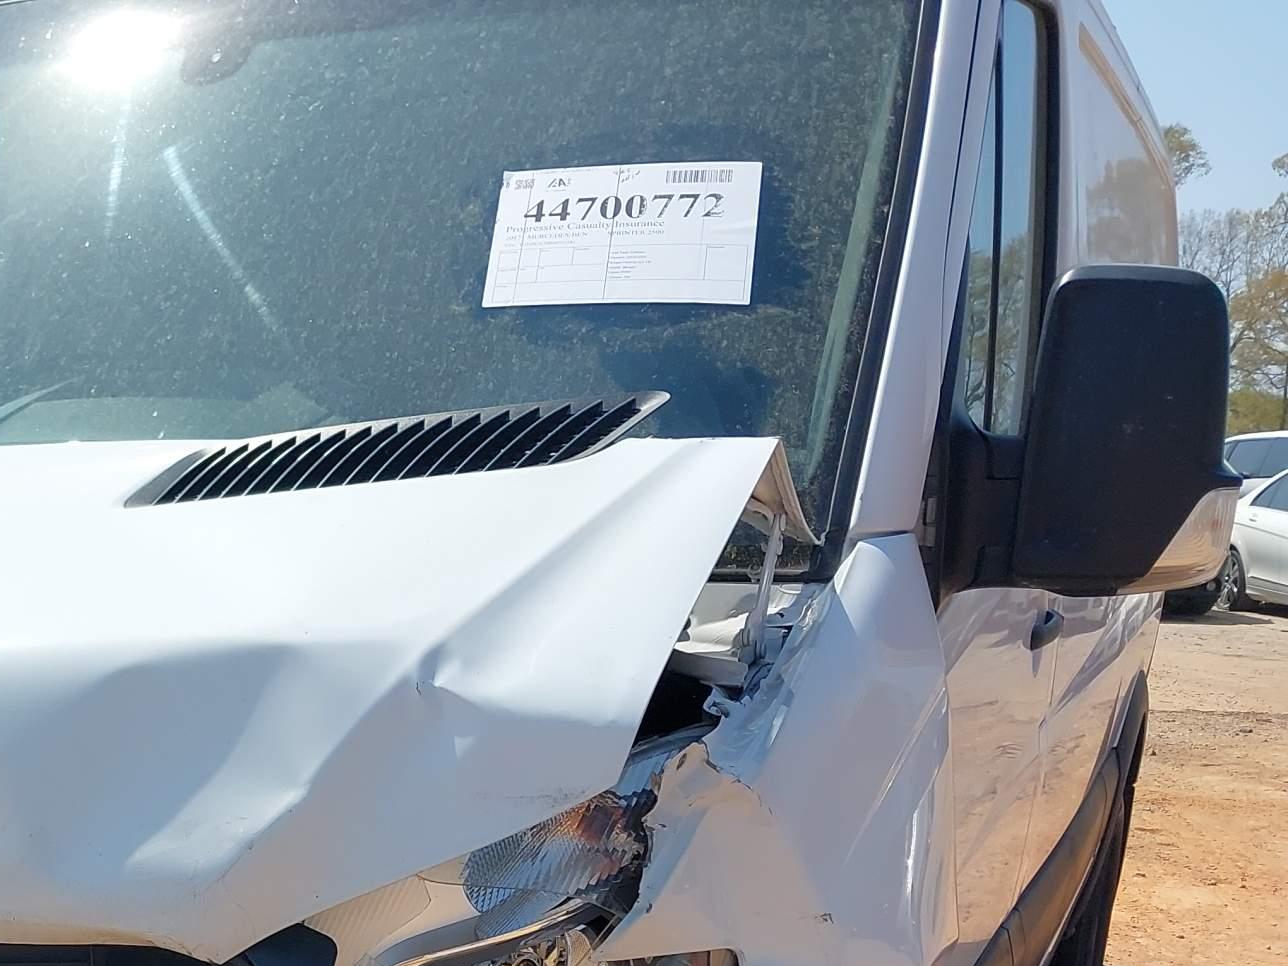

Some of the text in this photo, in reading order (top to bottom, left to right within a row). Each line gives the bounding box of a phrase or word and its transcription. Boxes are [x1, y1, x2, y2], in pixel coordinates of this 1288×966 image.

[523, 192, 725, 223] 44700772
[506, 220, 665, 233] Progressive Casualty Insurance
